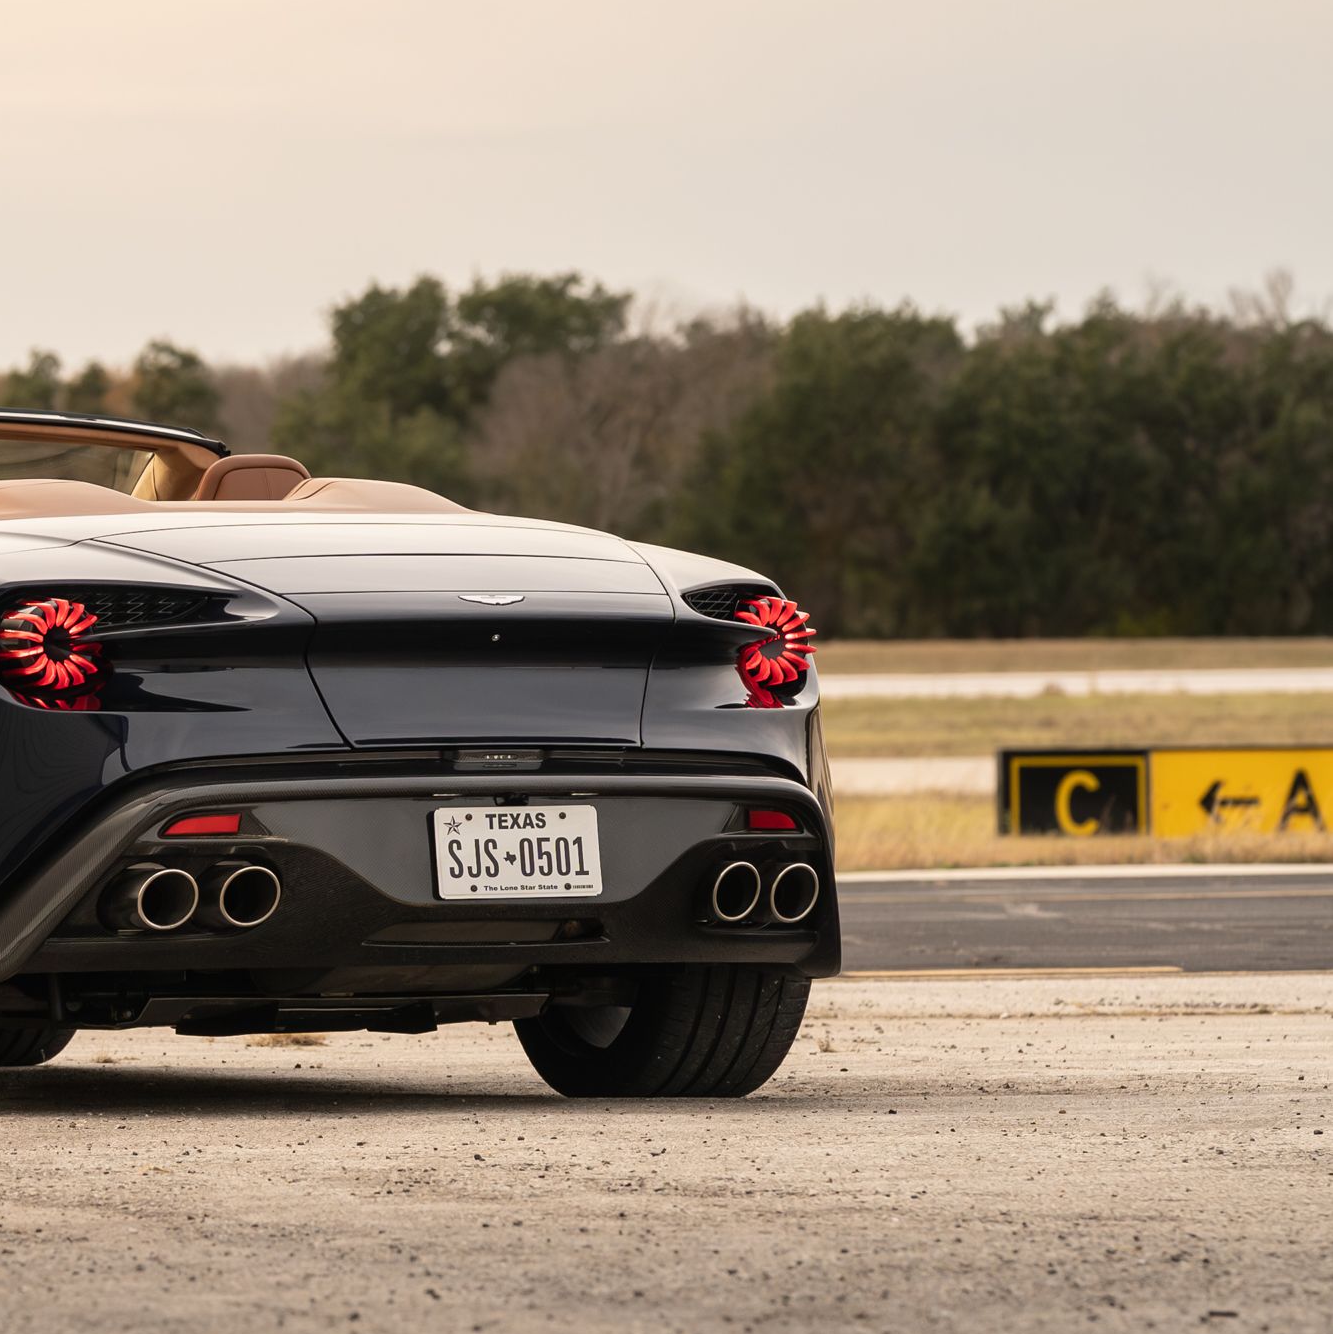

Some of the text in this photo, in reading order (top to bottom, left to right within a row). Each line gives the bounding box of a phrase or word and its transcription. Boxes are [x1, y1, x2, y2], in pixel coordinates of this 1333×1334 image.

[485, 812, 546, 830] TEXAS
[1055, 768, 1327, 835] C A
[448, 836, 589, 878] SJS 0501
